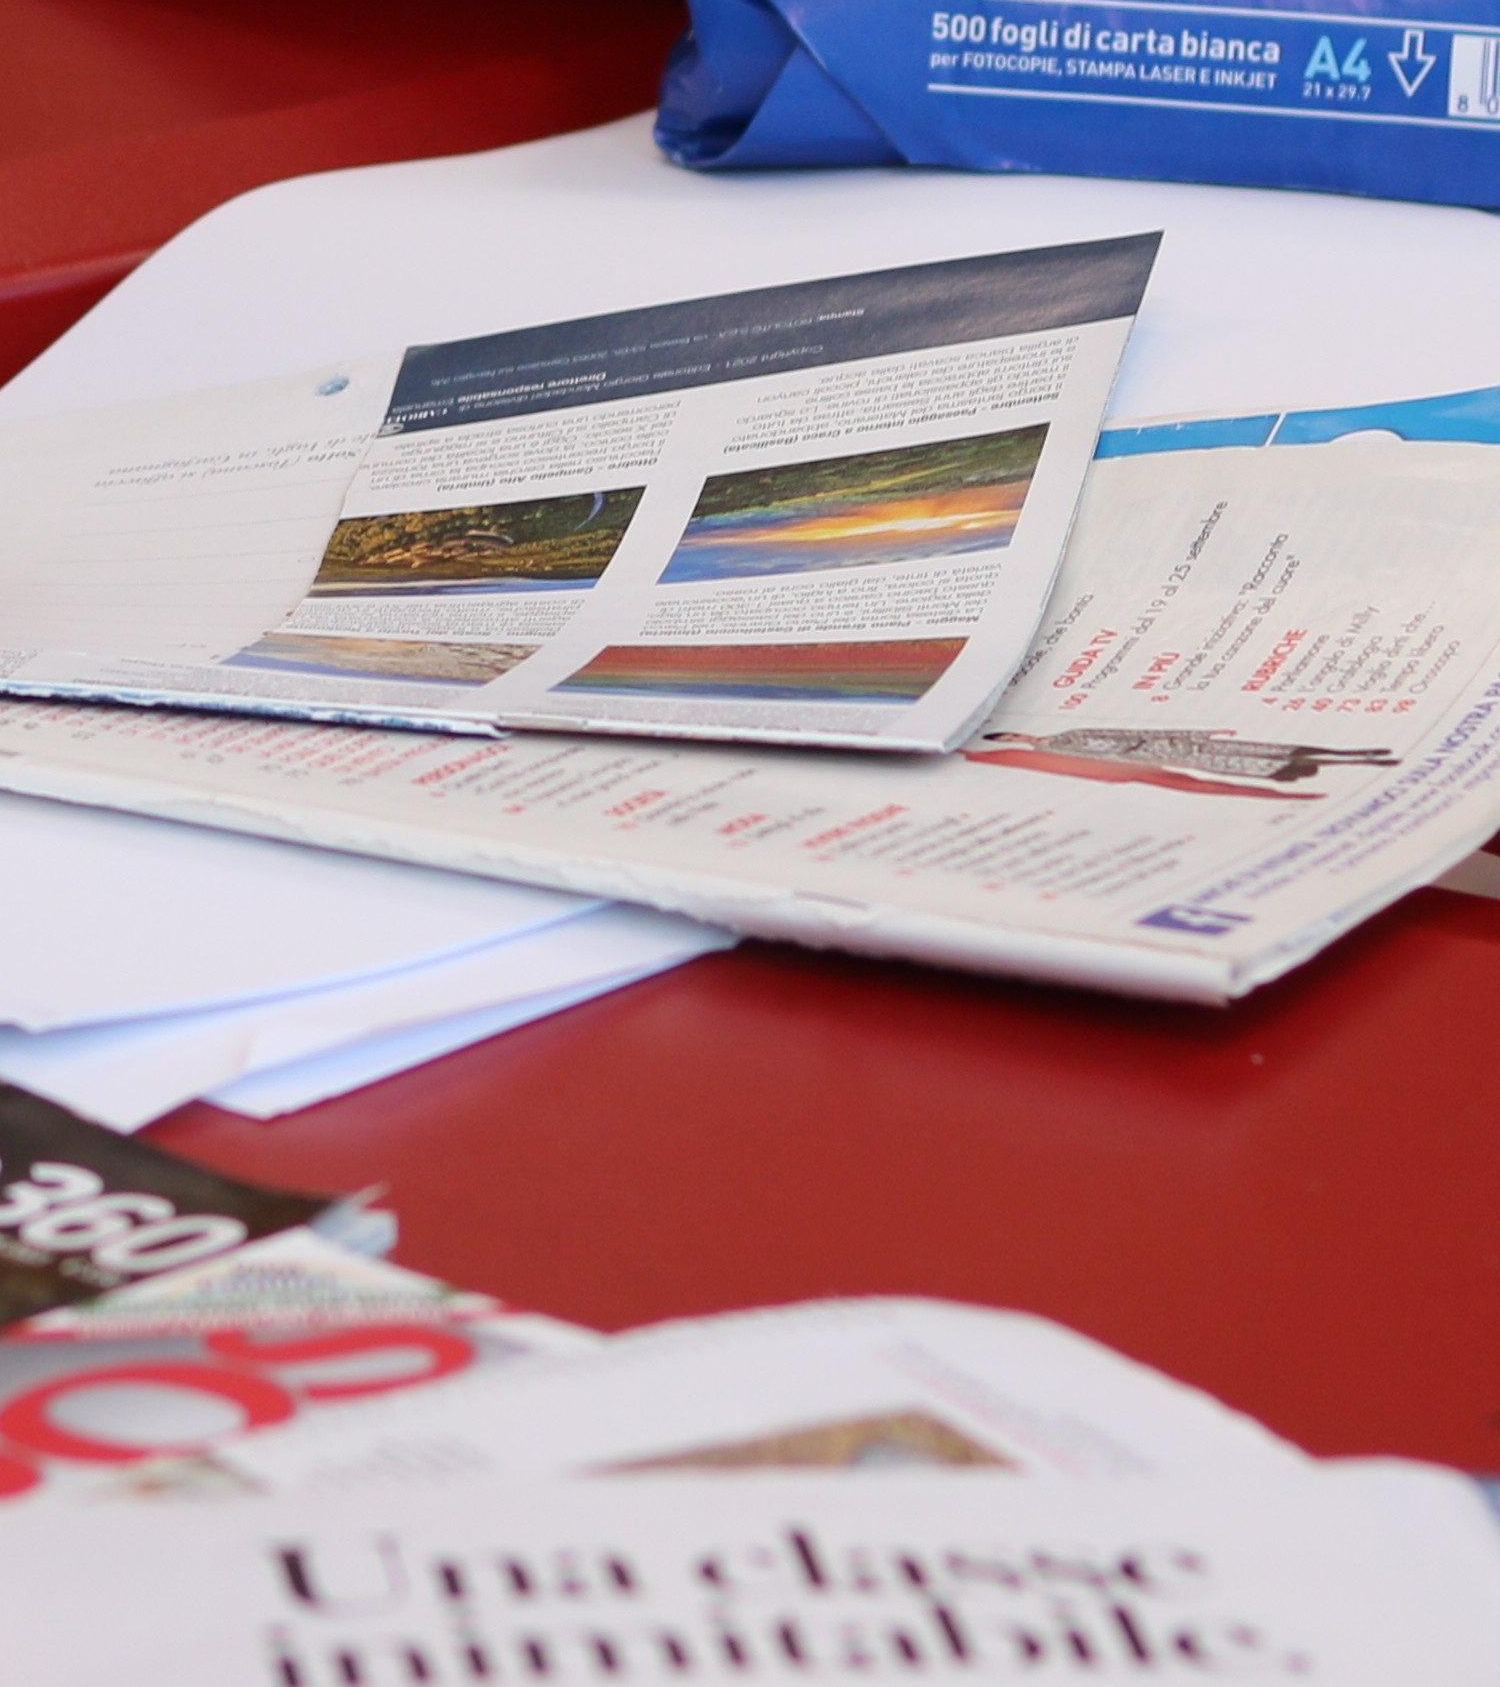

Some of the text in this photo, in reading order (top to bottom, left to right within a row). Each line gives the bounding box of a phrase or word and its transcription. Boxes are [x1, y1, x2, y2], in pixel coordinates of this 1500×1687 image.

[932, 12, 1281, 64] 500 fogli di carta bianca
[1303, 34, 1372, 82] A4
[929, 52, 1277, 90] per FOTOCOPIE, STAMPA LASER E INKJET
[1303, 82, 1371, 101] 21 x 29.7
[1457, 97, 1469, 113] 8
[1006, 383, 1052, 398] borgo
[909, 402, 934, 414] del
[935, 391, 1004, 410] fantasma
[989, 391, 1059, 410] Settembre
[800, 426, 842, 441] Craco
[856, 416, 905, 432] intorno
[721, 433, 799, 454] (Basilicata)
[528, 465, 594, 481] Campello
[606, 456, 658, 471] Ottobre
[1184, 498, 1229, 563] settembre
[924, 614, 980, 625] Maggio
[1050, 639, 1103, 691] GUIDA
[1093, 626, 1120, 652] TV
[1240, 626, 1309, 695] RUBRICHE
[266, 1525, 1208, 1615] Una classe
[262, 1593, 1312, 1687] inimitabile.
